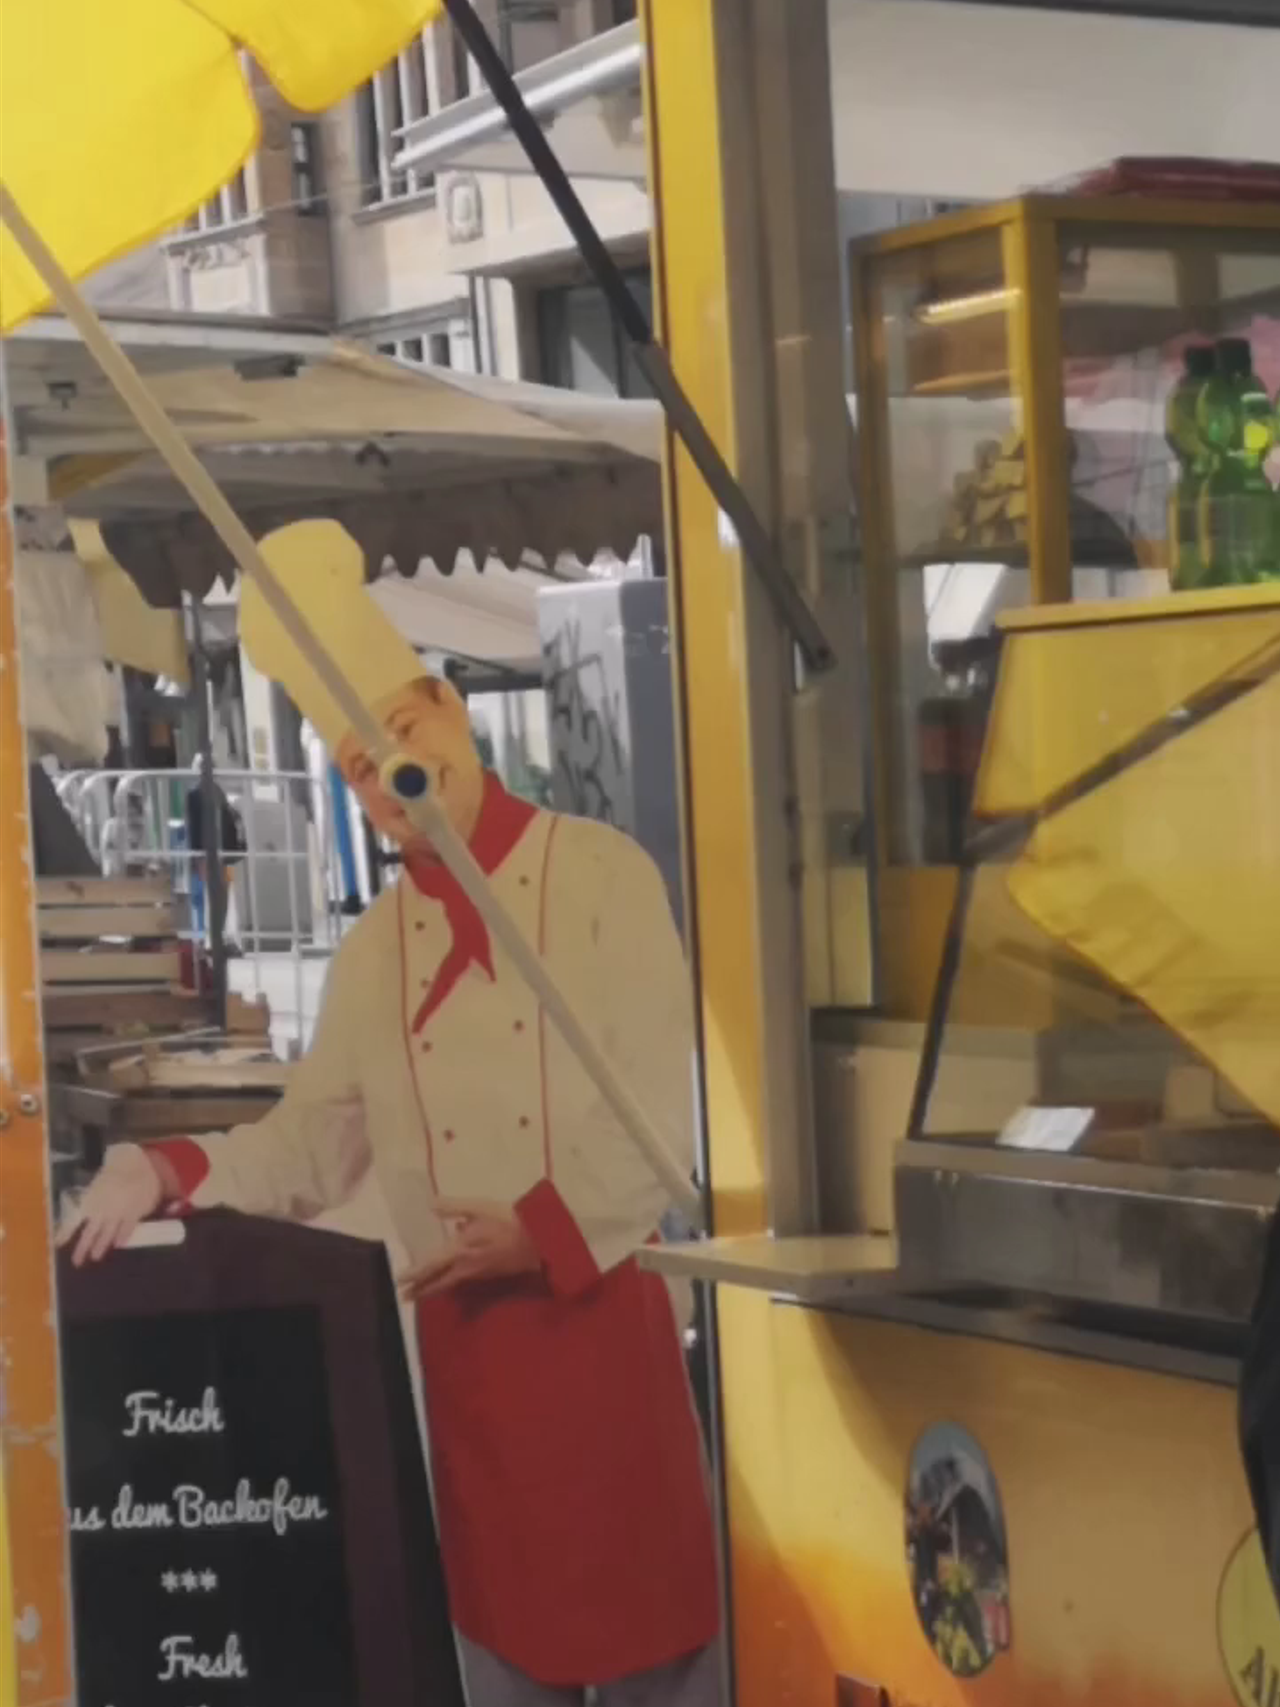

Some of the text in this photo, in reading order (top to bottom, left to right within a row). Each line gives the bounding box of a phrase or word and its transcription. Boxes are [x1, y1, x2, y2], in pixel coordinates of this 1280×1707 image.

[123, 1387, 225, 1438] Frisch
[69, 1478, 329, 1537] us dem Backofen
[158, 1634, 248, 1682] Fresh
